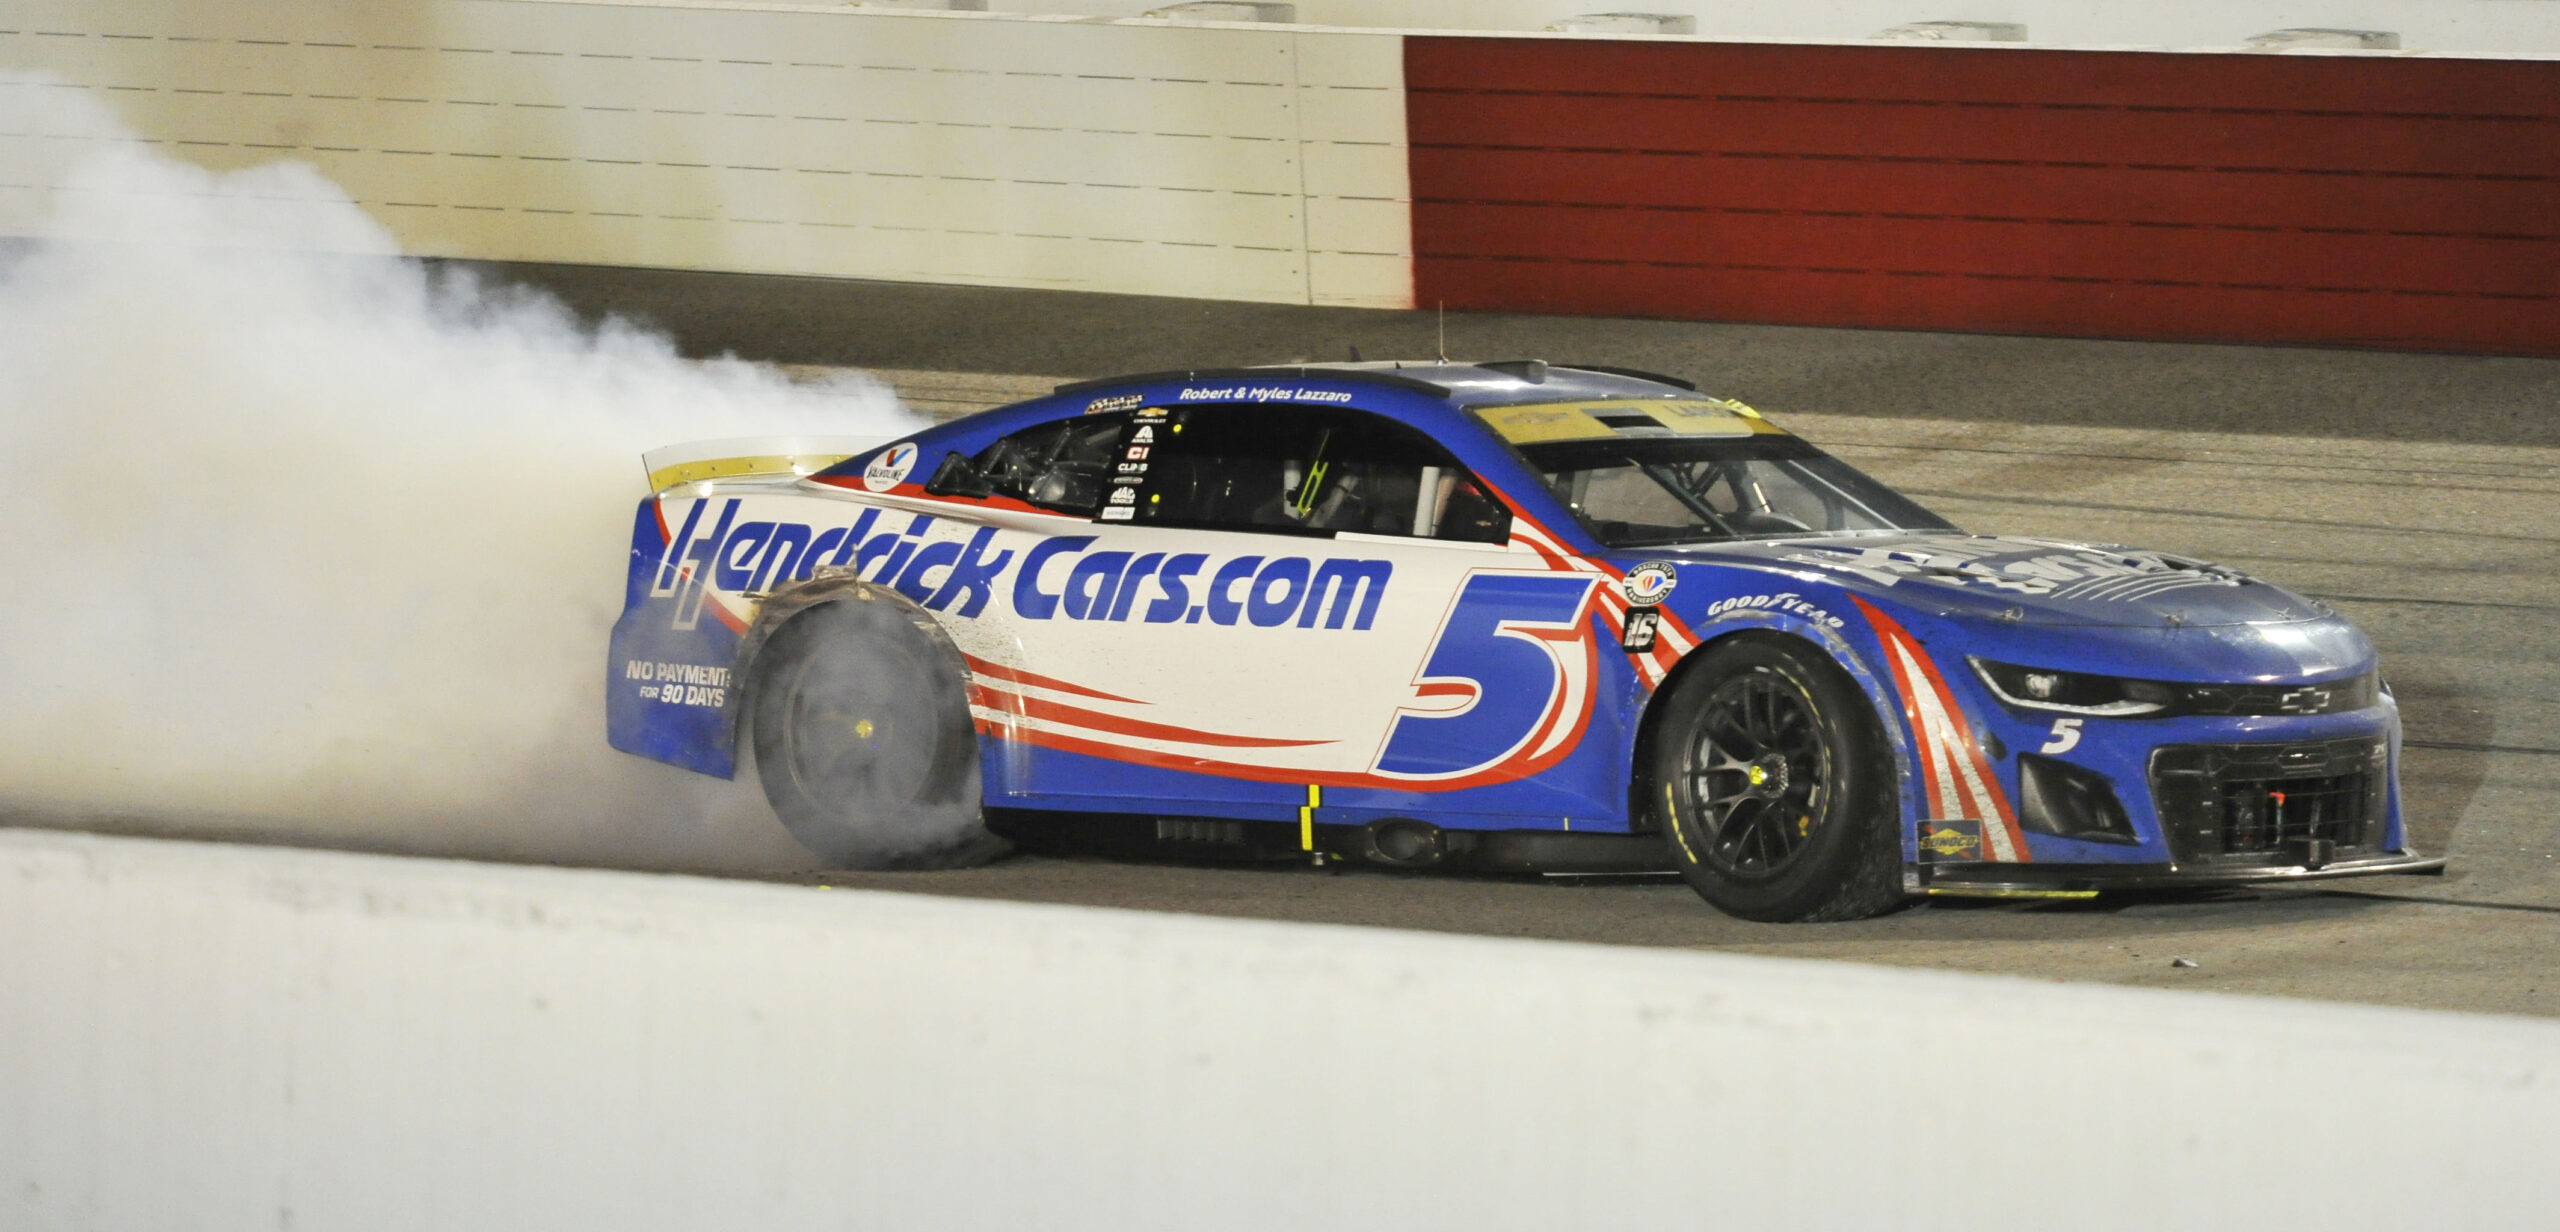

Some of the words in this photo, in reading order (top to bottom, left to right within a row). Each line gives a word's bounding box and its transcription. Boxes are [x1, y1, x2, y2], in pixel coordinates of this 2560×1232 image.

[1180, 388, 1233, 400] Robert
[1234, 387, 1247, 399] &
[1250, 387, 1293, 403] Myles
[1294, 388, 1352, 403] Lazzaro
[626, 660, 654, 680] NO
[1368, 567, 1598, 780] 5
[640, 686, 659, 699] FOR
[661, 684, 684, 704] 90
[685, 686, 724, 707] DAYS
[2040, 718, 2084, 755] 5
